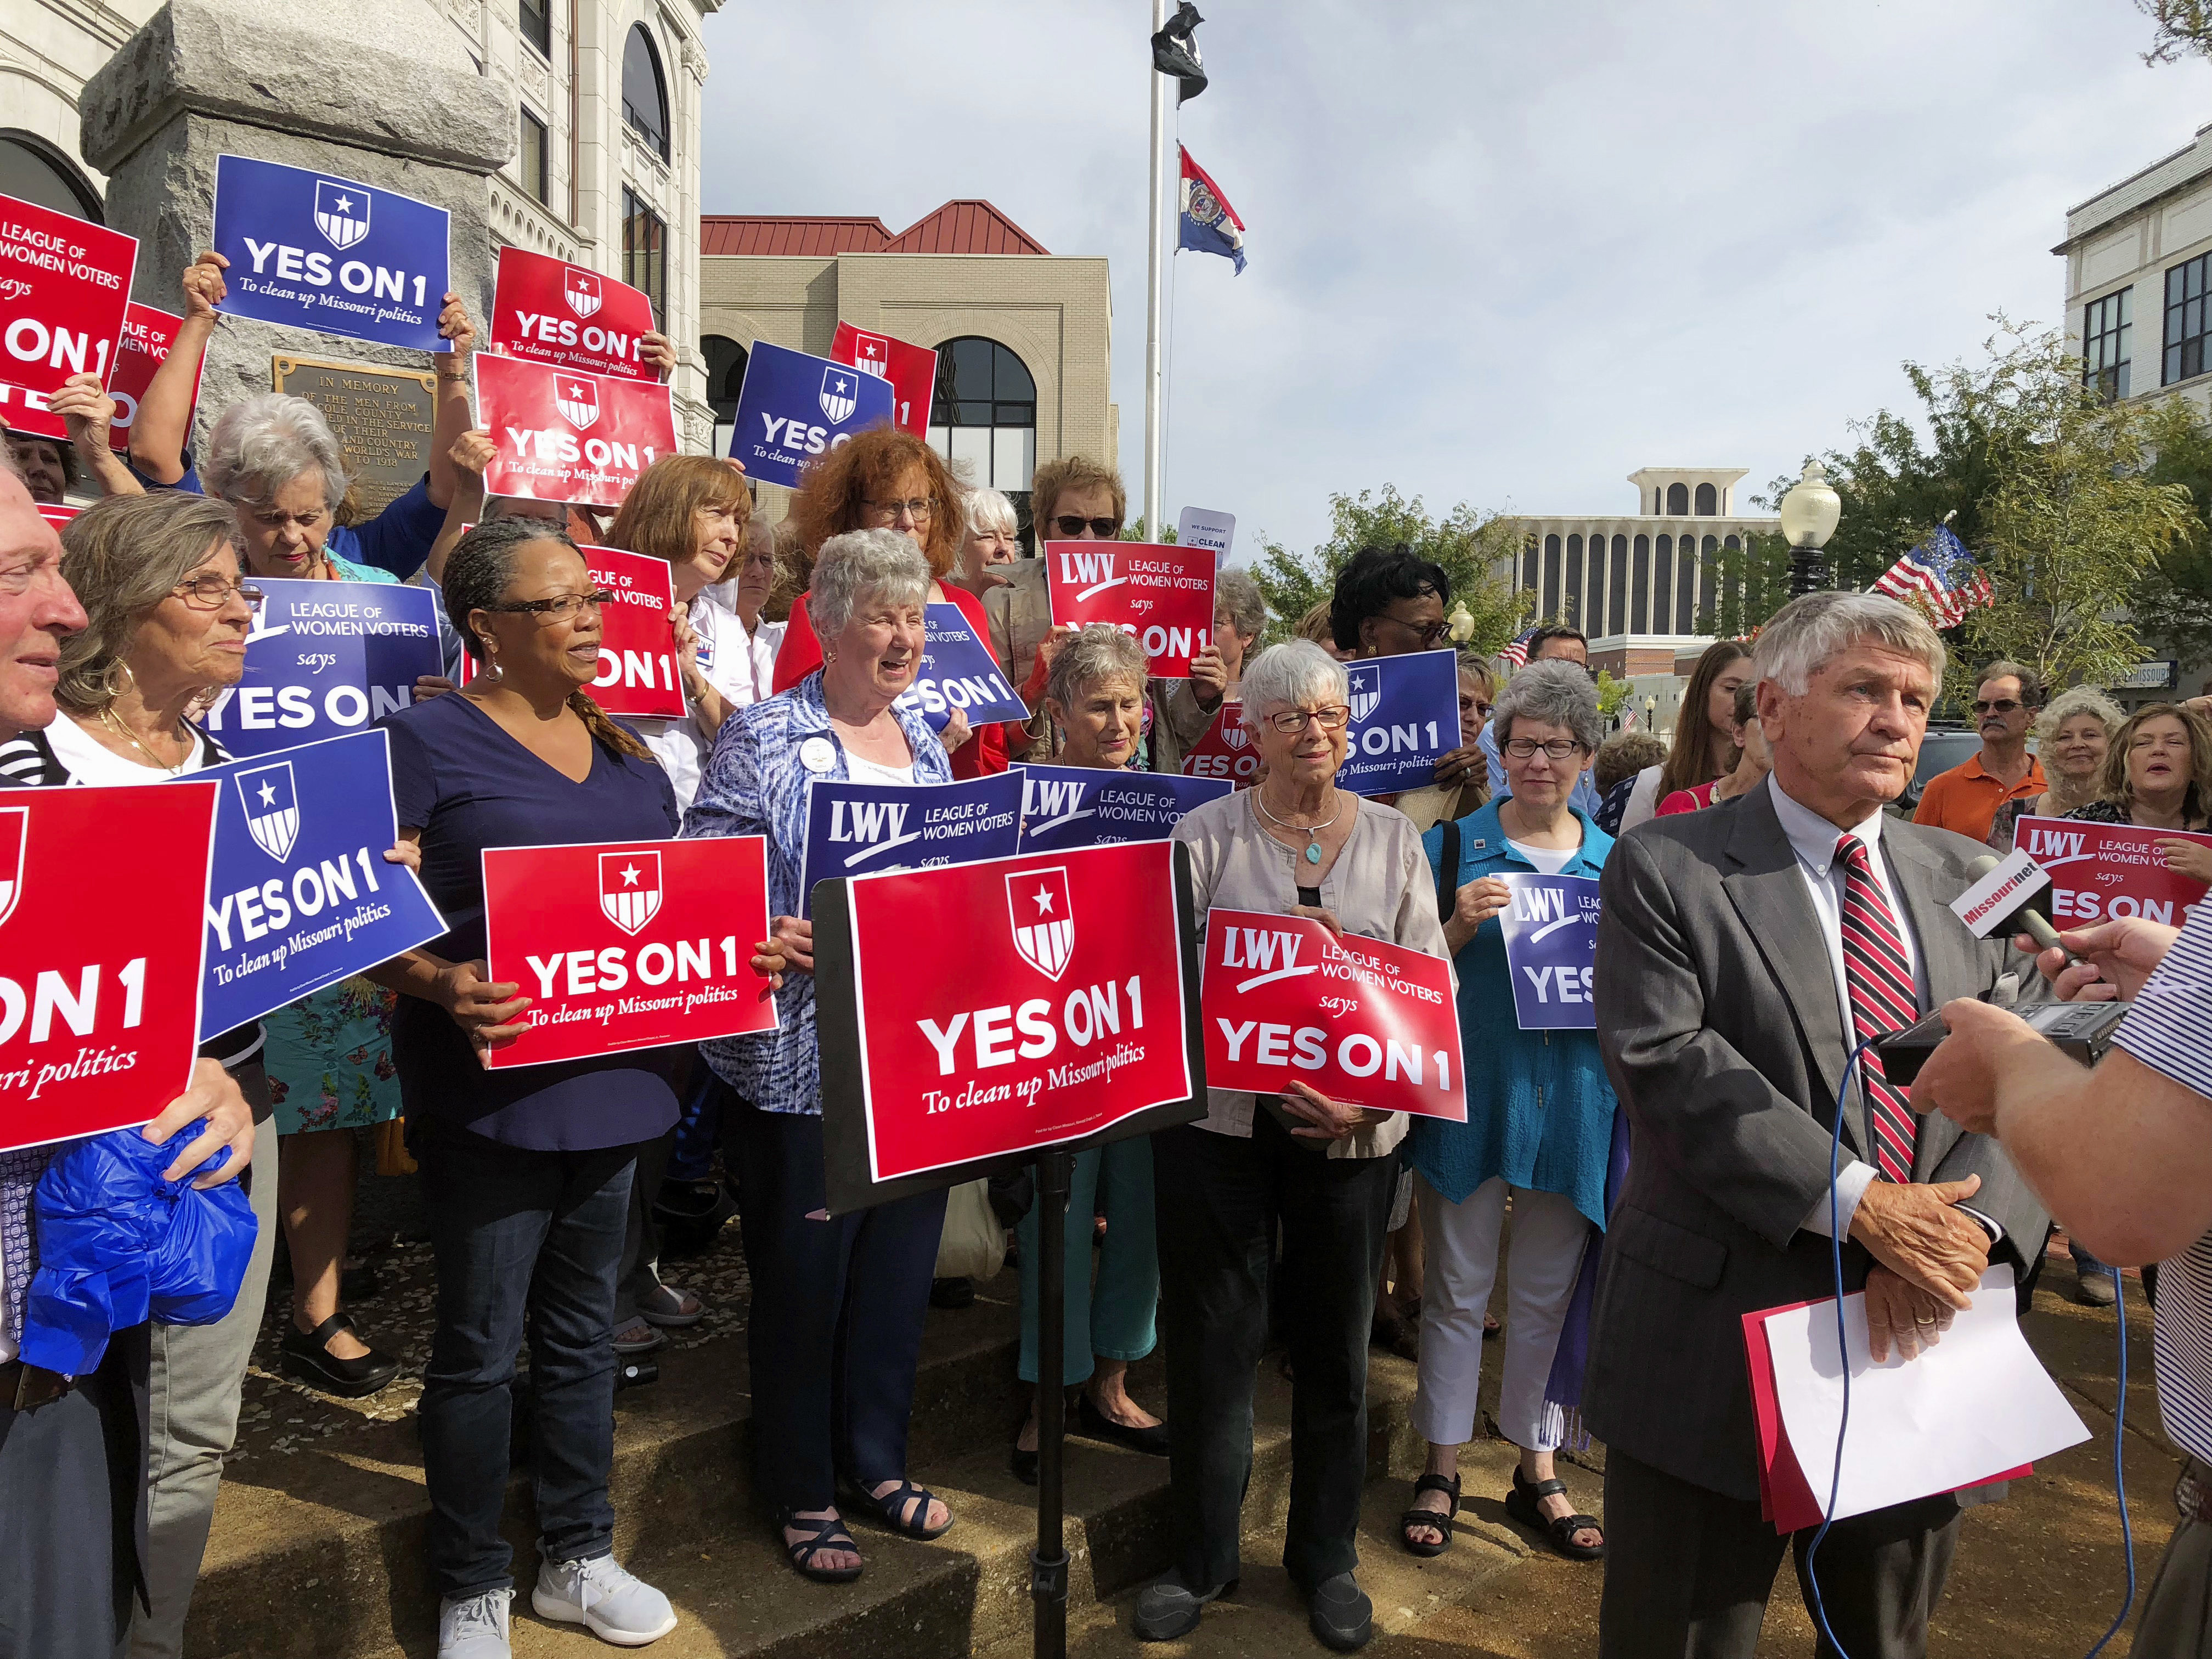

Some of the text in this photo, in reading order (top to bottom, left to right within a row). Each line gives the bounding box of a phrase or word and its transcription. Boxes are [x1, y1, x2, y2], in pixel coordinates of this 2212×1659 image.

[2, 221, 87, 259] LEAGUE OF
[0, 240, 120, 290] WOMEN VOTERS
[242, 236, 426, 307] YES ON 1
[0, 275, 33, 300] ays
[239, 276, 423, 325] To clean up Missouri politics
[4, 318, 110, 379] ON 1
[119, 339, 148, 354] MEN
[151, 331, 167, 343] OF
[515, 310, 641, 362] YES ON 1
[511, 340, 638, 376] To clean up Missouri politics
[319, 376, 399, 396] IN MEMORY
[302, 391, 417, 413] OF THE MEN FROM
[317, 403, 404, 421] COLE COUNTY
[900, 401, 911, 425] 1
[333, 424, 388, 438] OF THEIR
[346, 415, 358, 425] IN
[362, 417, 384, 428] THE
[387, 420, 432, 433] SERVICE
[761, 412, 828, 455] YES
[341, 435, 419, 451] AND COUNTRY
[343, 444, 419, 460] WORLD'S WAR
[505, 427, 656, 471] YES ON 1
[354, 455, 398, 468] TO 1918
[509, 461, 524, 473] To
[526, 462, 555, 477] clean
[556, 467, 572, 483] up
[573, 467, 620, 484] Missouri
[753, 444, 768, 458] To
[768, 449, 796, 465] clean
[797, 458, 811, 473] up
[1198, 538, 1226, 549] CLEAN
[1201, 526, 1227, 534] SUPPORT
[619, 575, 633, 588] OF
[1059, 552, 1184, 584] LWV LEAGUE OF
[1128, 574, 1208, 591] WOMEN VOTERS
[290, 602, 382, 619] LEAGUE OF
[620, 590, 663, 610] VOTERS
[1130, 597, 1154, 616] says
[291, 620, 428, 638] WOMEN VOTERS
[928, 620, 938, 629] OF
[936, 630, 970, 643] VOTERS
[1142, 625, 1192, 658] ON
[1197, 628, 1207, 659] 1
[296, 651, 336, 674] says
[590, 647, 674, 691] ON 1
[920, 653, 936, 670] ays
[206, 685, 410, 731] YES ON
[895, 673, 1013, 717] ES ON 1
[1361, 723, 1419, 756] ON
[1424, 720, 1438, 749] 1
[1336, 768, 1348, 783] up
[1350, 758, 1397, 776] Missouri
[1023, 779, 1177, 816] LWV LEAGUE OF
[828, 800, 989, 843] LWV LEAGUE OF
[923, 814, 1013, 841] WOMEN VOTERS
[1098, 805, 1156, 824] WOMEN
[2028, 828, 2087, 857] LWV
[2099, 839, 2149, 854] LEAGUE
[2097, 851, 2151, 866] WOMEN
[2095, 870, 2124, 887] says
[206, 846, 380, 952] YES ON 1
[1511, 887, 1565, 922] LWV
[1962, 861, 2039, 926] Missourinet
[2052, 888, 2101, 919] ES
[2107, 894, 2174, 926] ON
[213, 901, 392, 987] To clean up Missouri politics
[1221, 926, 1401, 977] LWV LEAGUE OF
[525, 935, 737, 1000] YES ON 1
[117, 956, 148, 1029] 1
[1321, 962, 1443, 1005] WOMEN VOTERS
[527, 984, 738, 1028] To clean up Missouri politics
[1318, 993, 1358, 1019] says
[915, 974, 1144, 1076] YES ON 1
[1216, 1017, 1451, 1092] YES ON 1
[26, 1045, 138, 1101] politics
[921, 1041, 1146, 1115] To clean up Missouri politics
